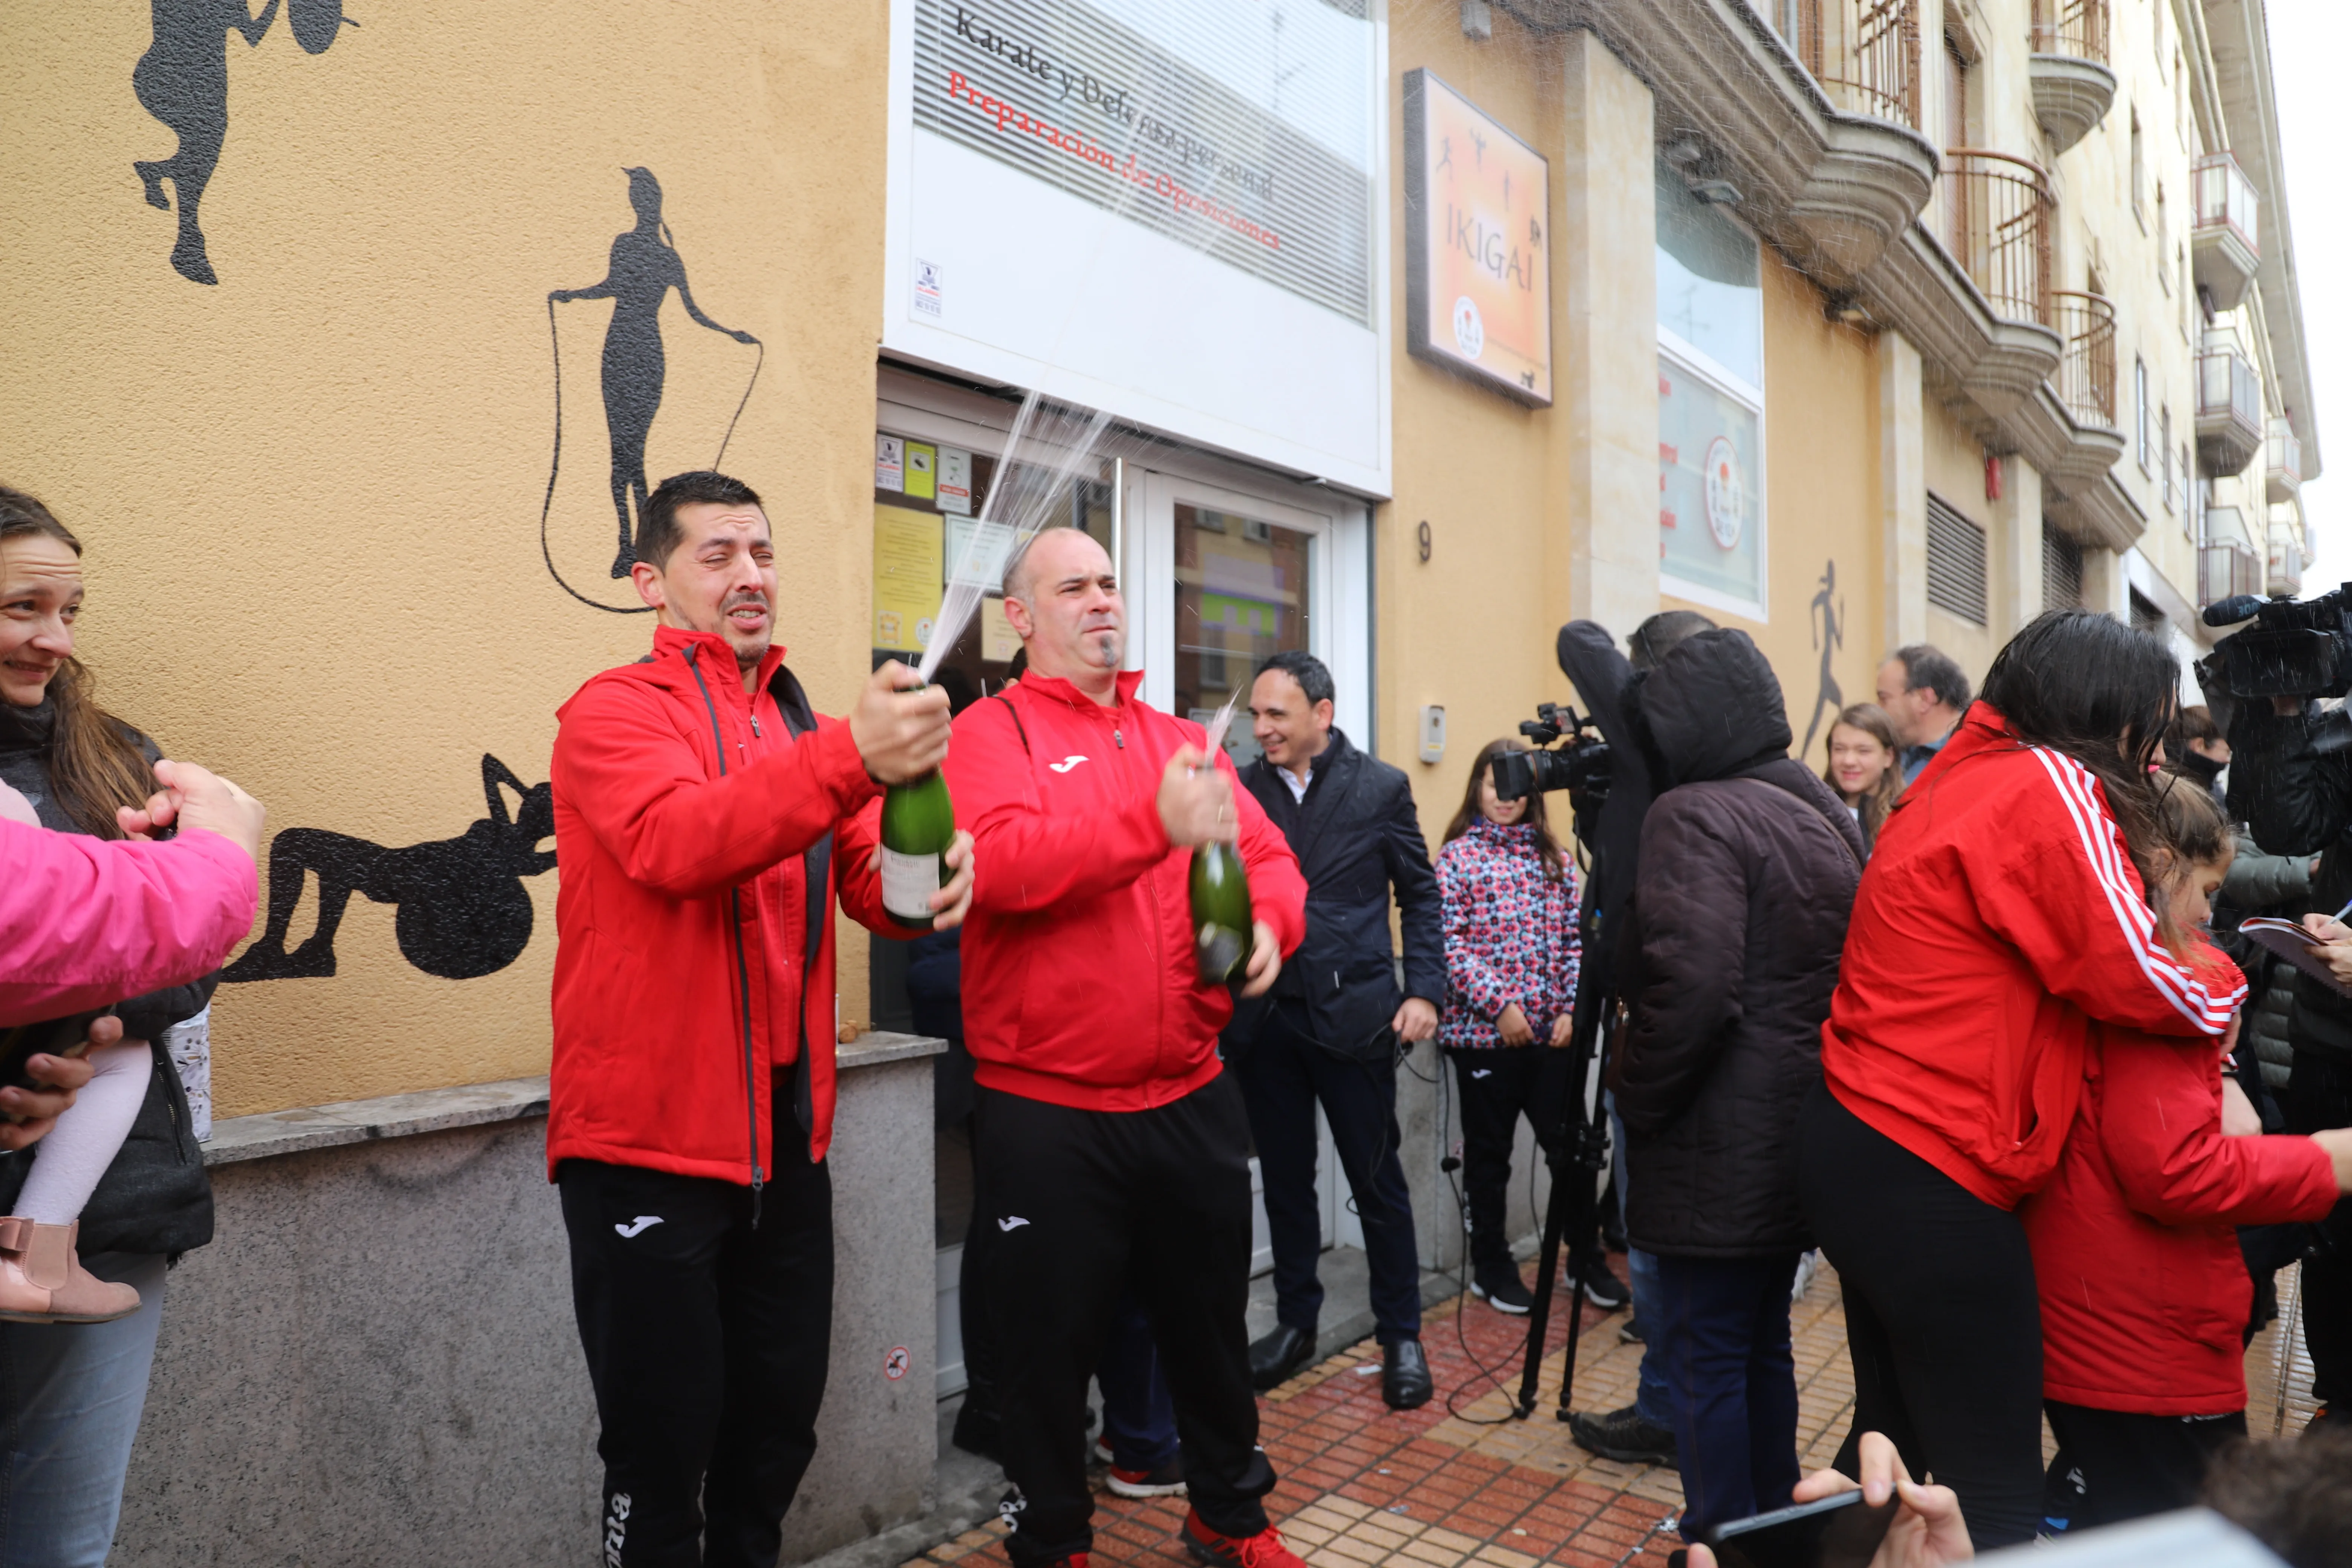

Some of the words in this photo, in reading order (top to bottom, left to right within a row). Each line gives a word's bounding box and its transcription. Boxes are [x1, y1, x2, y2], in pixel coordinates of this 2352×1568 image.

[957, 7, 1052, 80] Karate
[1058, 69, 1074, 102] y
[948, 71, 1116, 172] Preparación
[1122, 154, 1150, 187] de
[1156, 174, 1280, 250] Oposiciones
[1447, 202, 1533, 292] IKIGAI
[1418, 520, 1432, 562] 9
